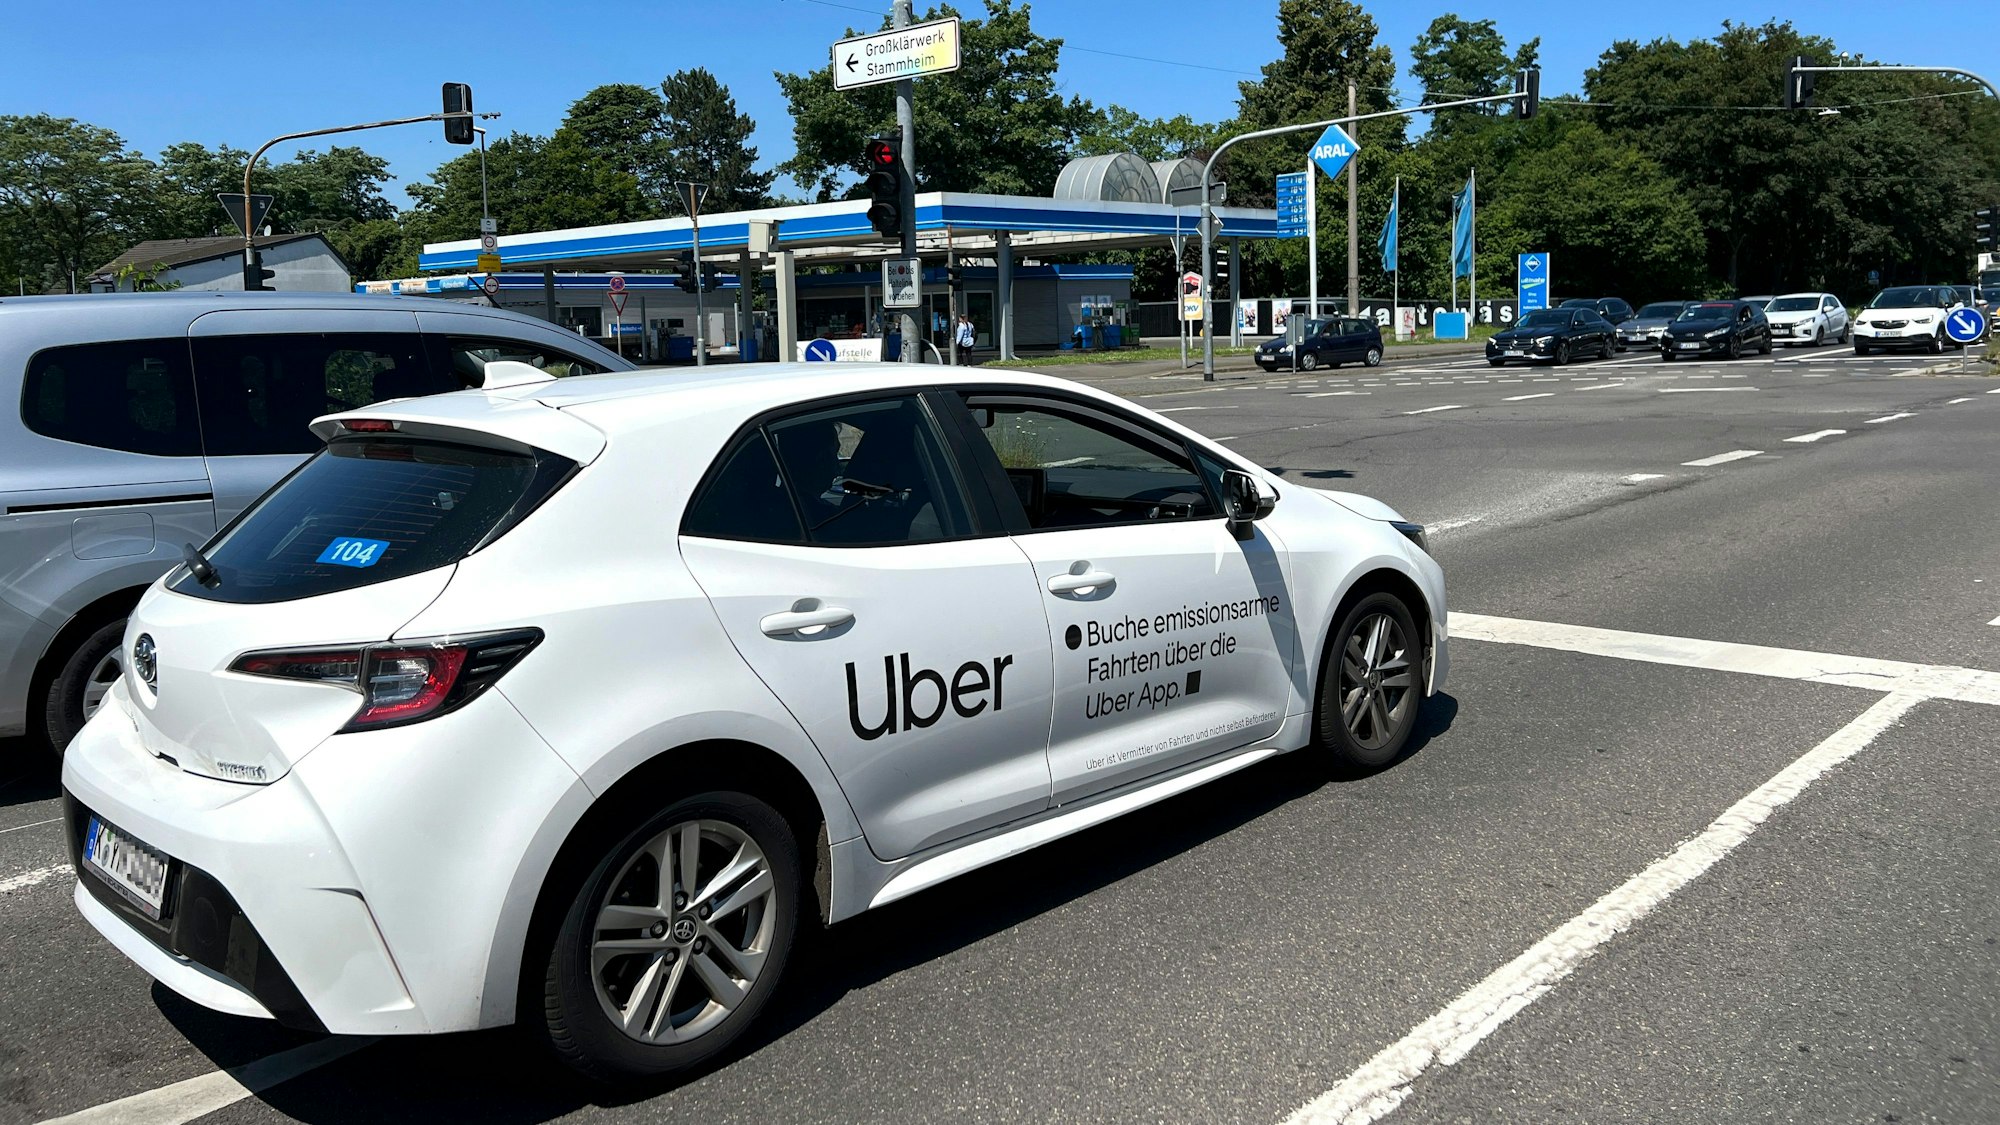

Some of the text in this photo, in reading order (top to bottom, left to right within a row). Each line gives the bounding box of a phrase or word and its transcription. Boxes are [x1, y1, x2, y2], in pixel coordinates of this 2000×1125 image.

[866, 29, 945, 57] Großklärwerk
[867, 53, 936, 76] Stammheim
[1314, 143, 1350, 160] ARAL
[888, 264, 915, 275] Bei bis
[888, 292, 915, 301] vorziehen
[331, 540, 378, 564] 104
[1087, 595, 1280, 647] Buche emissionsarme
[1088, 632, 1236, 684] Fahrten über die
[845, 652, 1013, 741] Uber
[1086, 681, 1181, 720] Uber App.
[1085, 758, 1105, 770] Uber
[1106, 754, 1116, 764] ist
[1116, 744, 1154, 761] Vermittler
[1154, 740, 1168, 752] von
[1168, 733, 1195, 748] Fahrten
[1195, 728, 1209, 740] und
[1209, 723, 1226, 736] nicht
[1226, 719, 1245, 732] selbst
